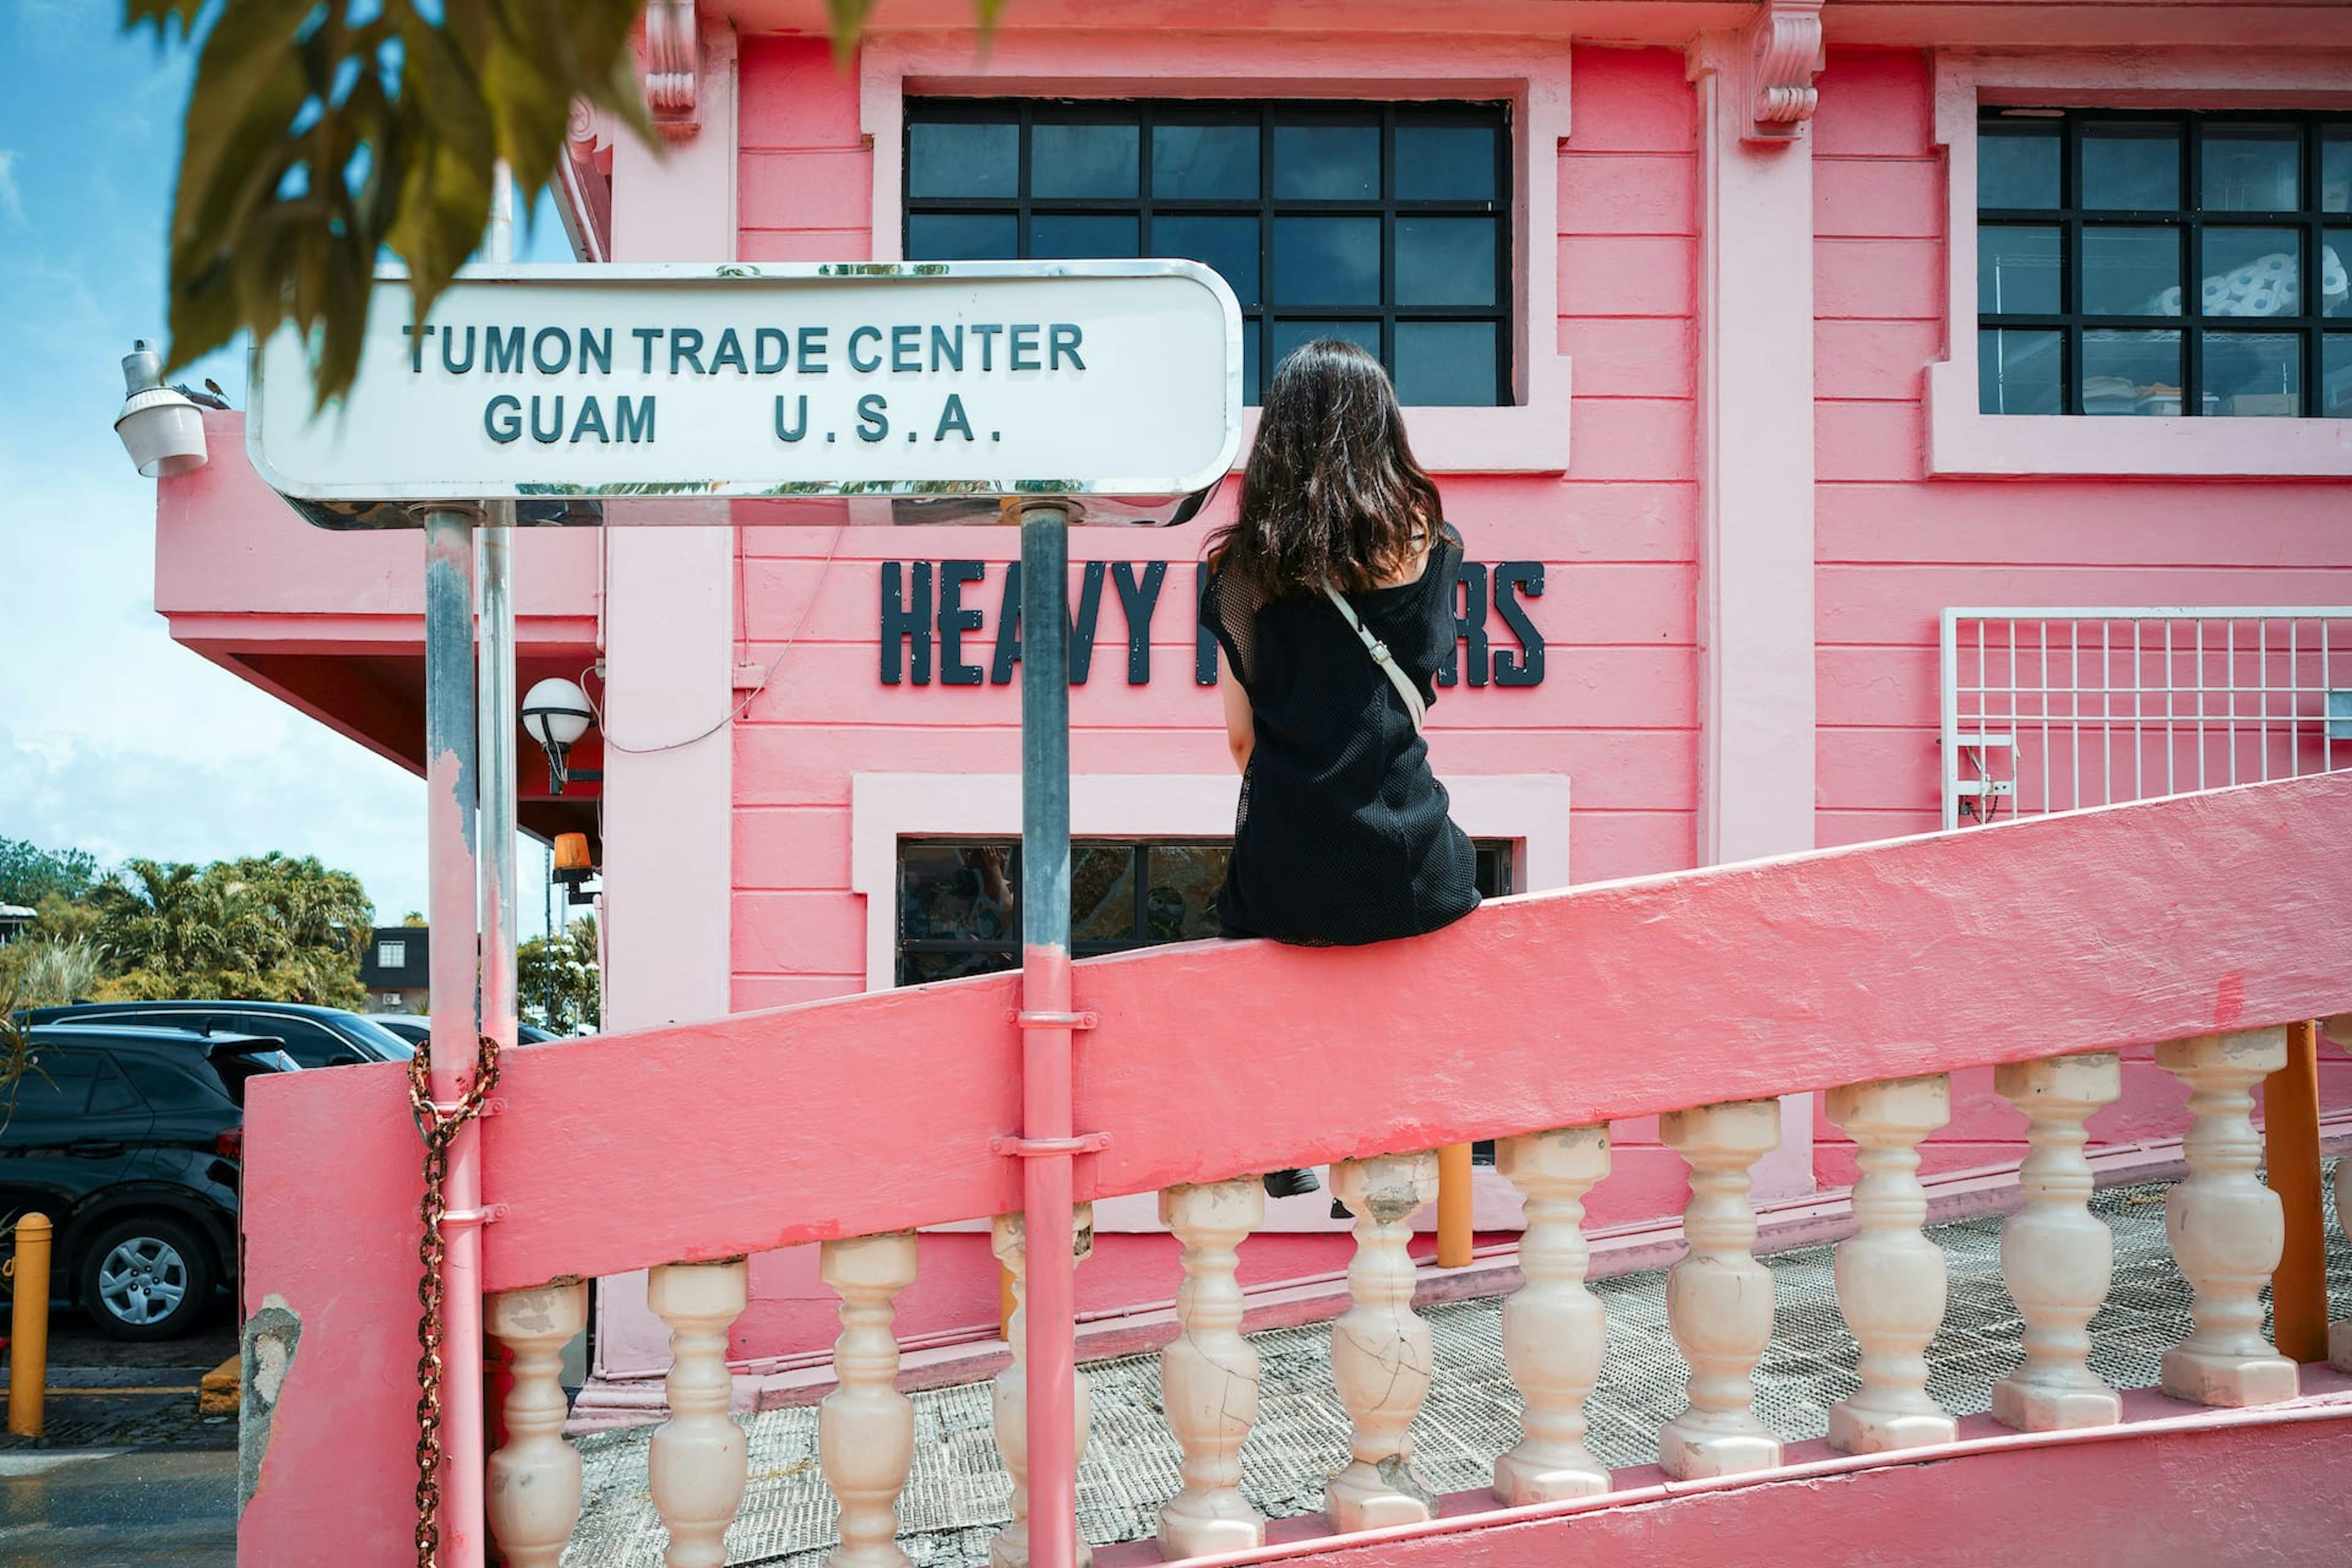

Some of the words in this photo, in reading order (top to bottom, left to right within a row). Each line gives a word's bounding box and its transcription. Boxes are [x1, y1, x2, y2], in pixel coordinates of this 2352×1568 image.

[402, 325, 612, 375] TUMON
[631, 327, 829, 375] TRADE
[848, 323, 1087, 374] CENTER
[484, 394, 656, 445] GUAM
[774, 393, 1001, 442] U.S.A.
